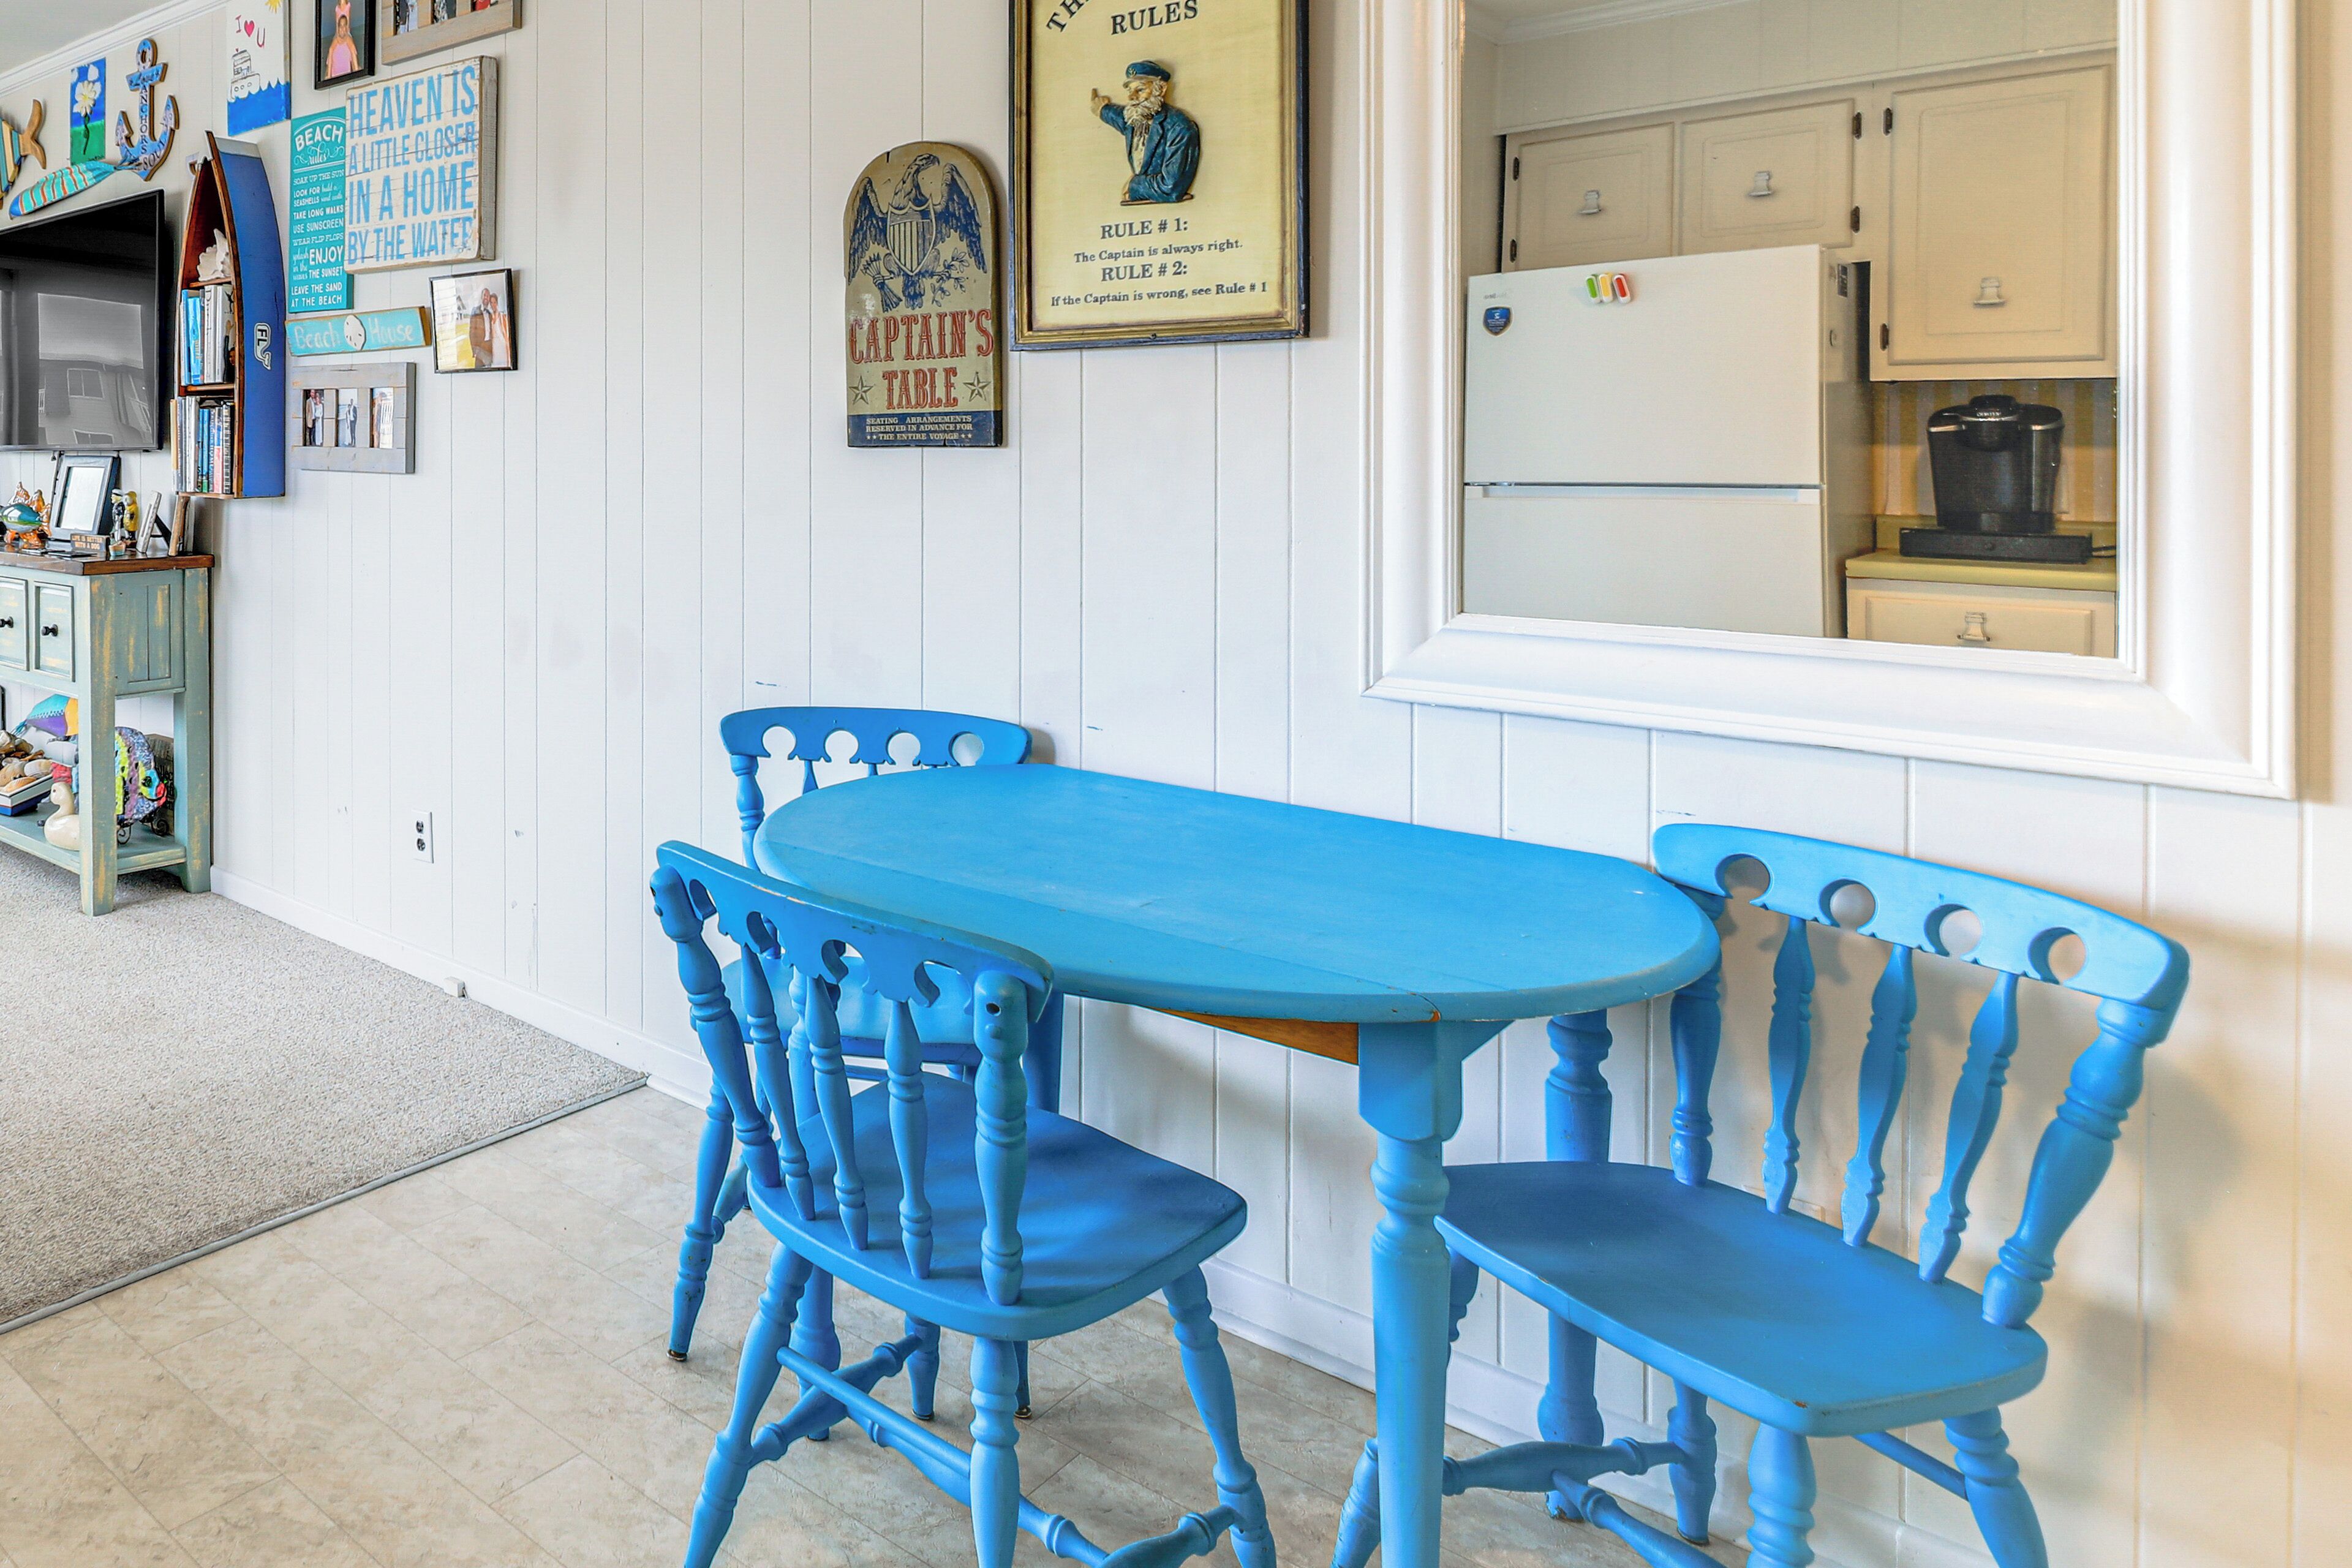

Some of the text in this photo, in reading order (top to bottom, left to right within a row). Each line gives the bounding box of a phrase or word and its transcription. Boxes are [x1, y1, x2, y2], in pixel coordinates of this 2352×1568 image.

[235, 15, 241, 33] I
[1046, 0, 1089, 32] TH
[1111, 0, 1199, 35] RULES
[350, 65, 476, 139] HEAVEN IS
[140, 84, 149, 154] ANCHORS
[295, 124, 344, 151] BEACH
[349, 121, 477, 175] A LITTLE CLOSER
[143, 137, 167, 171] SOUL
[293, 176, 308, 185] SOAK
[318, 172, 331, 181] THE
[331, 169, 344, 178] SUN
[294, 189, 307, 198] LOOK
[294, 196, 320, 207] SEASHELLS
[349, 160, 475, 225] IN A HOME
[293, 205, 344, 220] TAKE LONG WALKS
[293, 217, 344, 234] USE SUNSCREEN
[1101, 217, 1188, 239] RULE # 1:
[325, 233, 344, 241] FLOPS
[348, 229, 370, 265] BY
[374, 224, 405, 262] THE
[309, 245, 343, 266] ENJOY
[1074, 238, 1243, 263] The Captain is always right.
[309, 266, 343, 279] THE SUNSET
[1101, 260, 1188, 282] RULE # 2:
[292, 282, 342, 295] LEAVE THE SAND
[1051, 282, 1268, 306] If the Captain is wrong, see Rule # 1
[291, 295, 342, 307] AT THE BEACH
[258, 328, 268, 346] FL
[294, 317, 413, 349] Beach House
[849, 308, 994, 364] CAPTAIN'S
[882, 367, 959, 410] TABLE
[905, 415, 972, 424] ARRANGEMENTS
